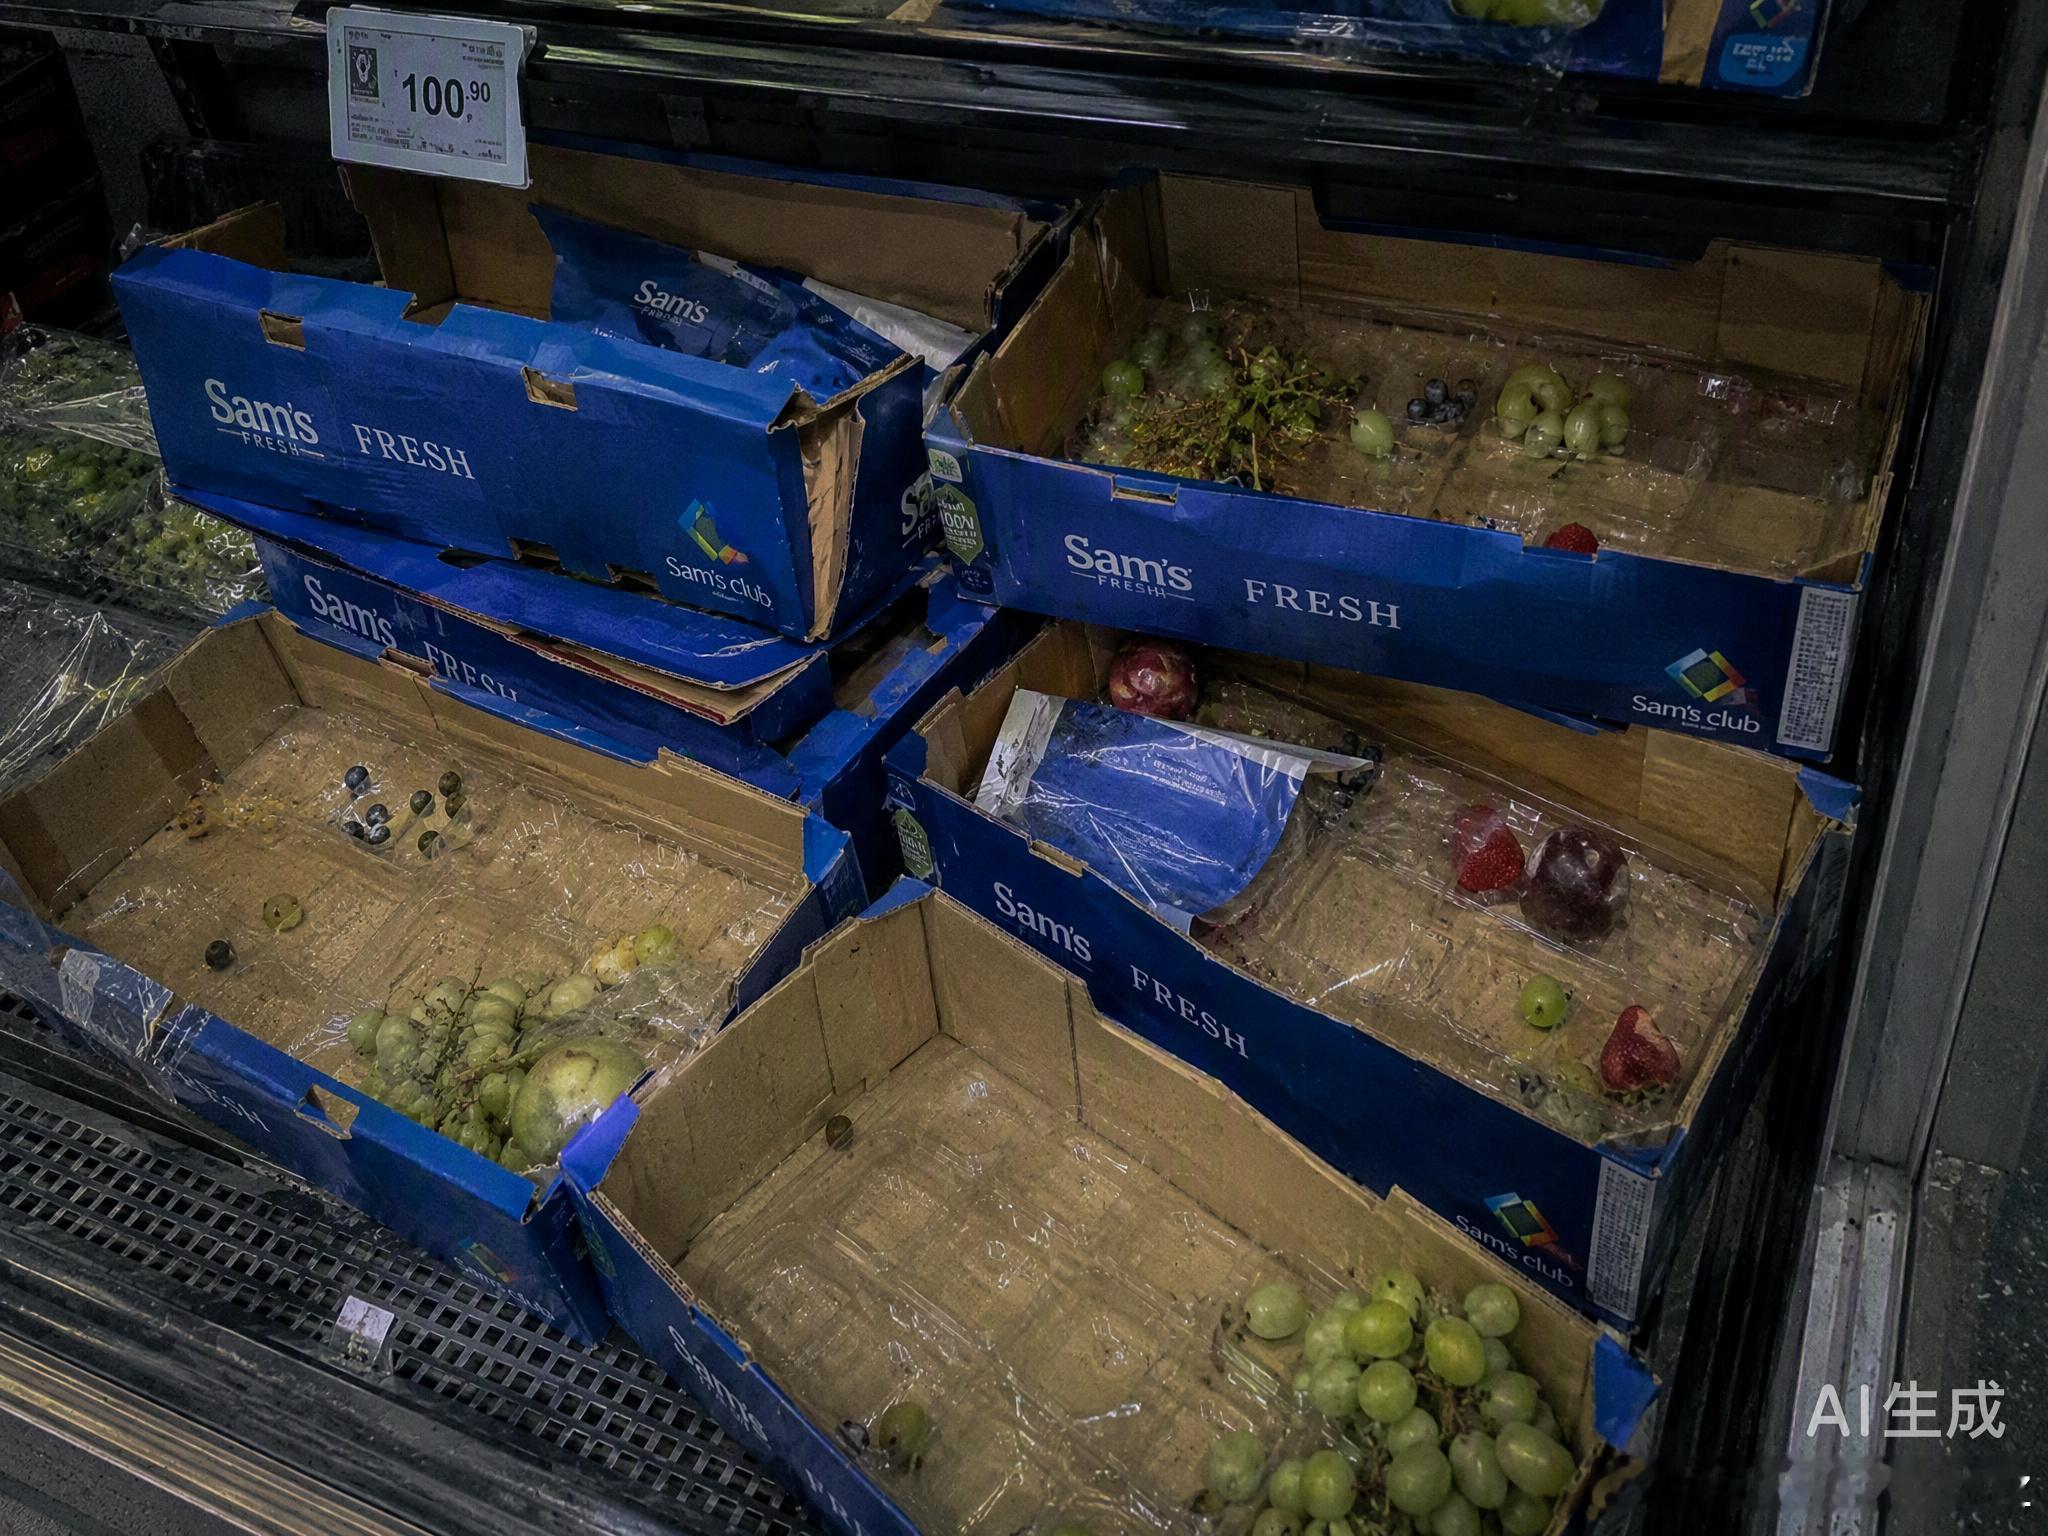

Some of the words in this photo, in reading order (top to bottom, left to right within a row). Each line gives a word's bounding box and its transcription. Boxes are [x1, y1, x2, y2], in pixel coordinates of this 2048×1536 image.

[634, 279, 709, 324] Sam's
[204, 378, 319, 444] Sam's
[351, 423, 475, 480] FRESH
[240, 430, 300, 457] FRESH
[303, 574, 397, 649] Sam's
[665, 556, 727, 591] Sam's
[730, 577, 772, 608] club
[1064, 534, 1194, 592] Sam's
[1243, 578, 1402, 629] FRESH
[1632, 695, 1701, 722] Sam's
[1706, 710, 1761, 734] club
[993, 881, 1092, 962] Sam's
[1129, 964, 1250, 1060] FRESH
[1455, 1214, 1518, 1261] Sam's
[1522, 1254, 1574, 1288] club
